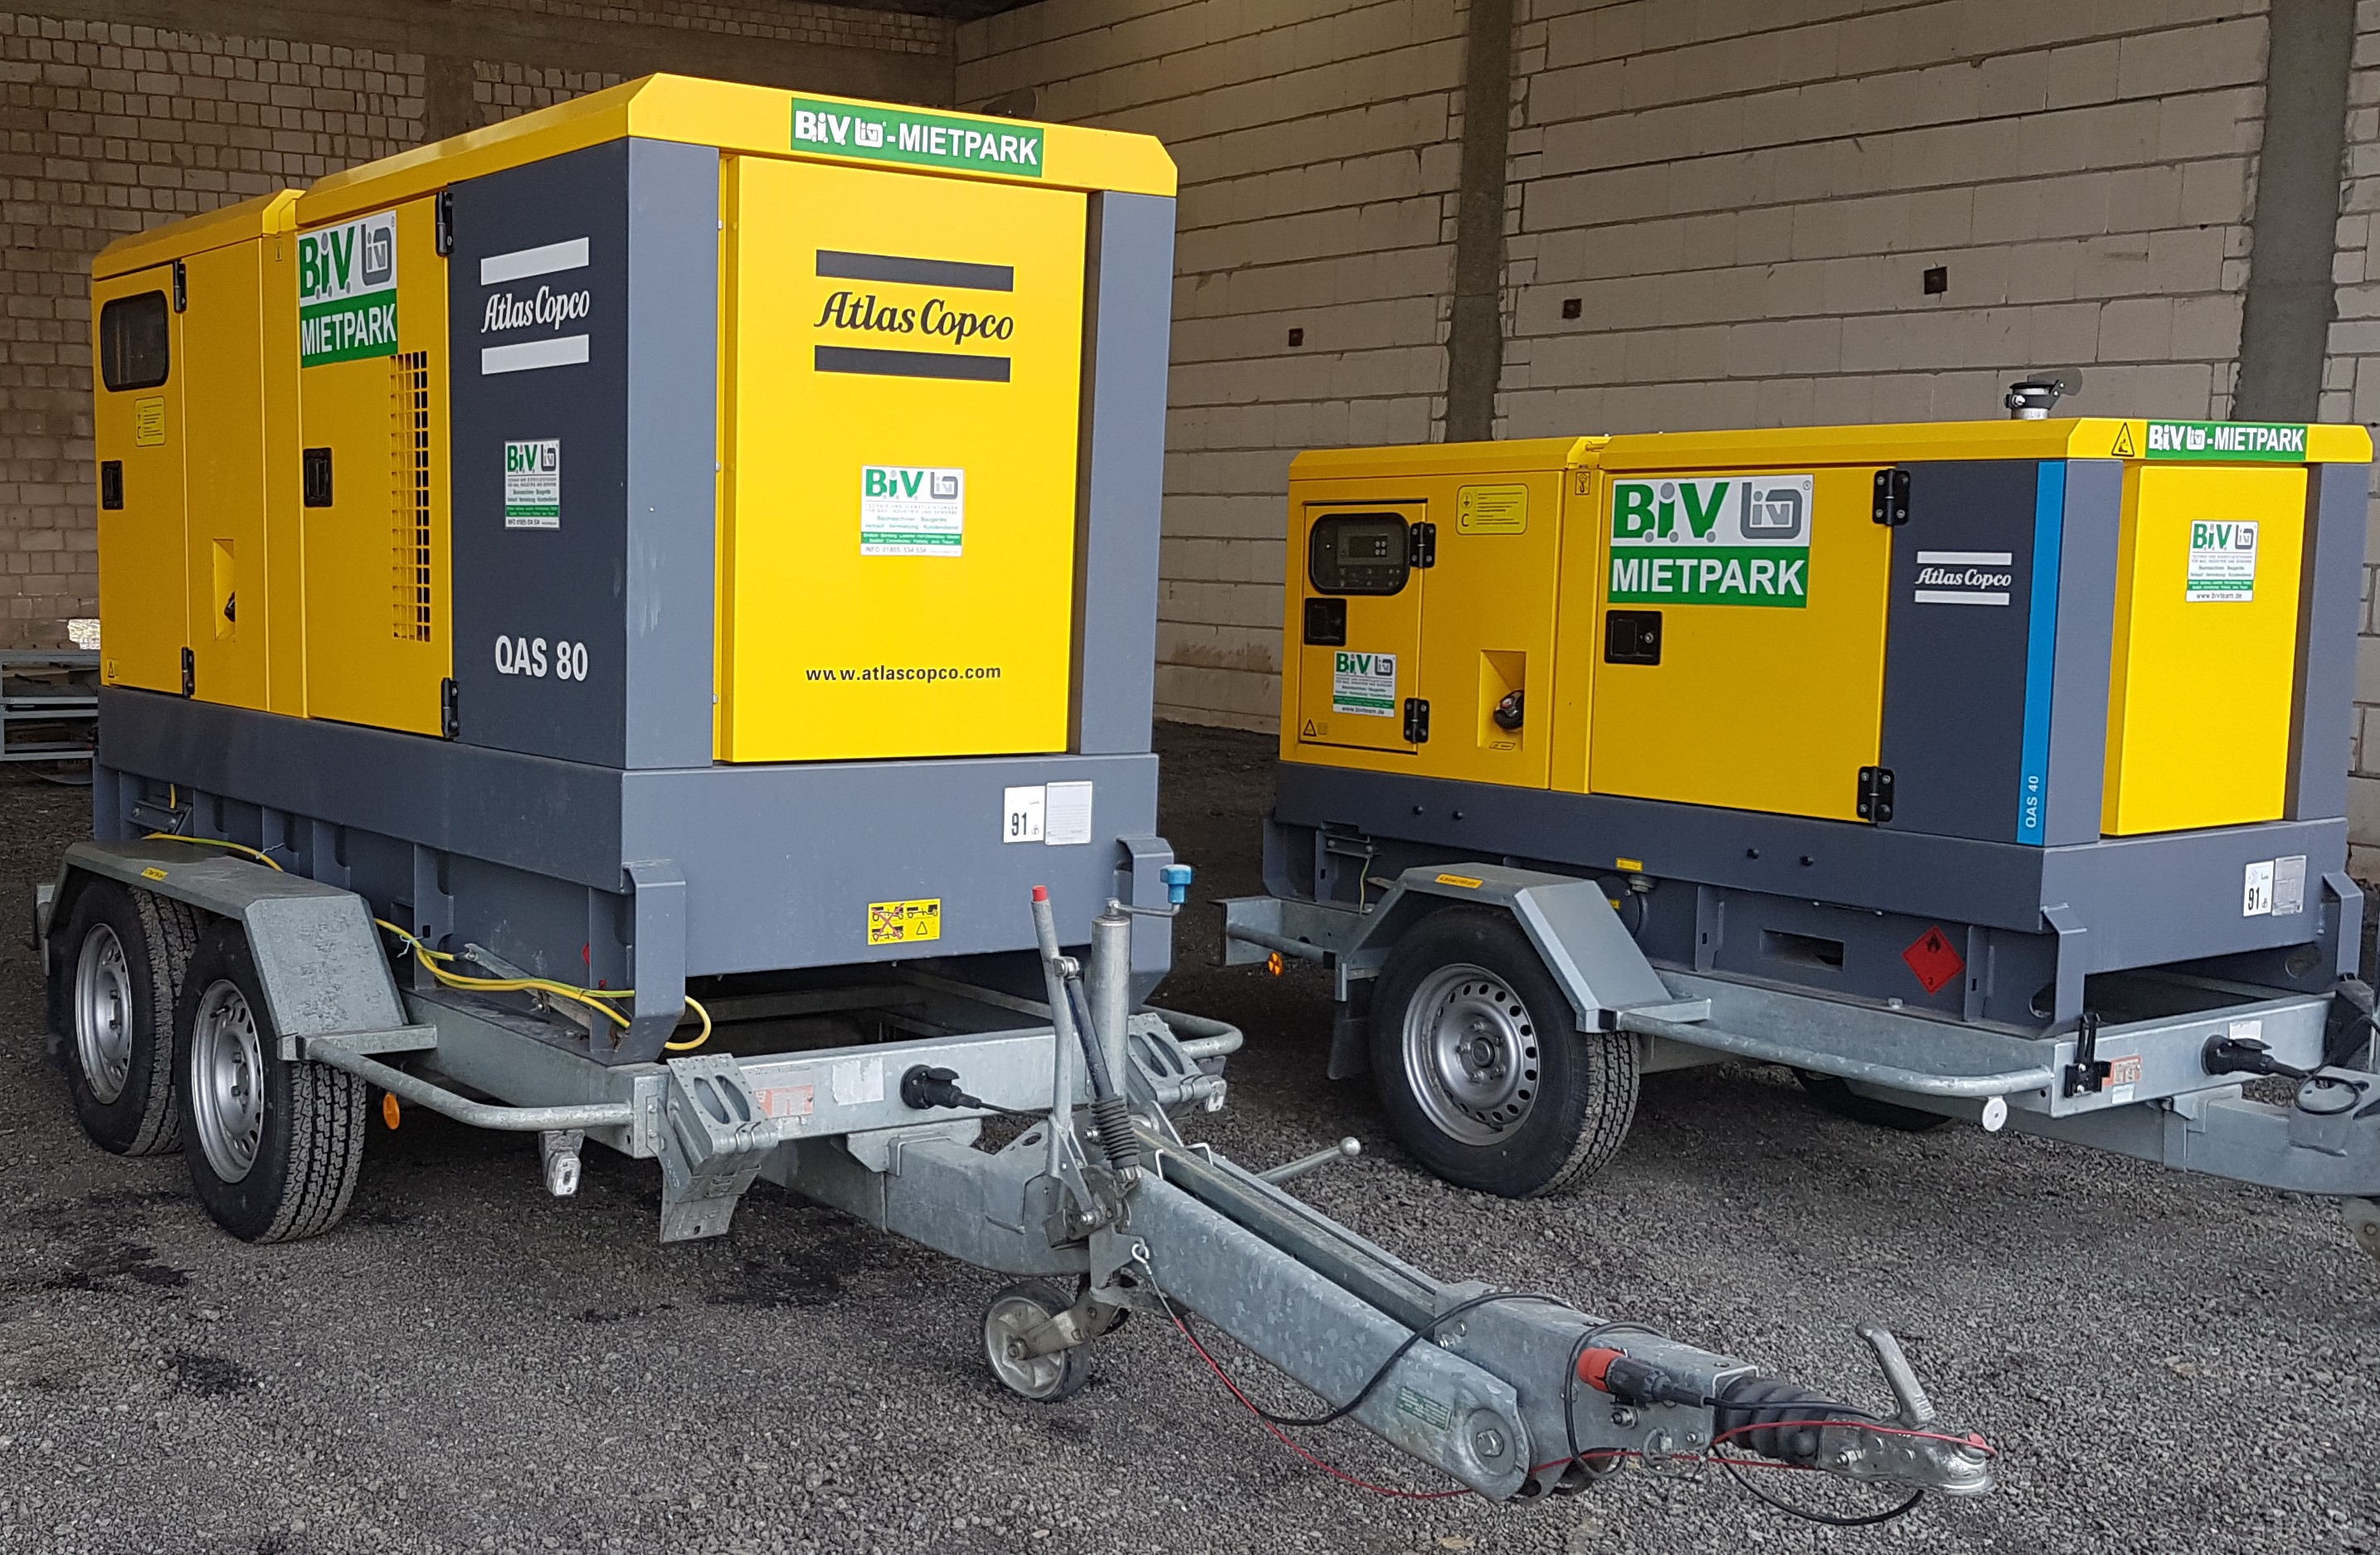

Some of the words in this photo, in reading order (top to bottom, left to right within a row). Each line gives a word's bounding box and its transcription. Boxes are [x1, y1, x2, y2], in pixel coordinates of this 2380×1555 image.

[480, 293, 533, 333] Atlas
[535, 285, 590, 331] Copco
[814, 291, 916, 333] Atlas
[920, 299, 1014, 345] Copco
[301, 303, 397, 357] MIETPARK
[1611, 558, 1806, 596] MIETPARK
[1914, 567, 1964, 586] Atlas
[1964, 568, 2012, 590] Copco
[494, 634, 548, 678] QAS
[556, 640, 588, 682] 80
[806, 664, 1001, 683] www.atlascopco.com
[2027, 775, 2039, 793] 40
[1011, 811, 1027, 836] 91
[2025, 796, 2038, 829] QAS
[2247, 886, 2260, 911] 91
